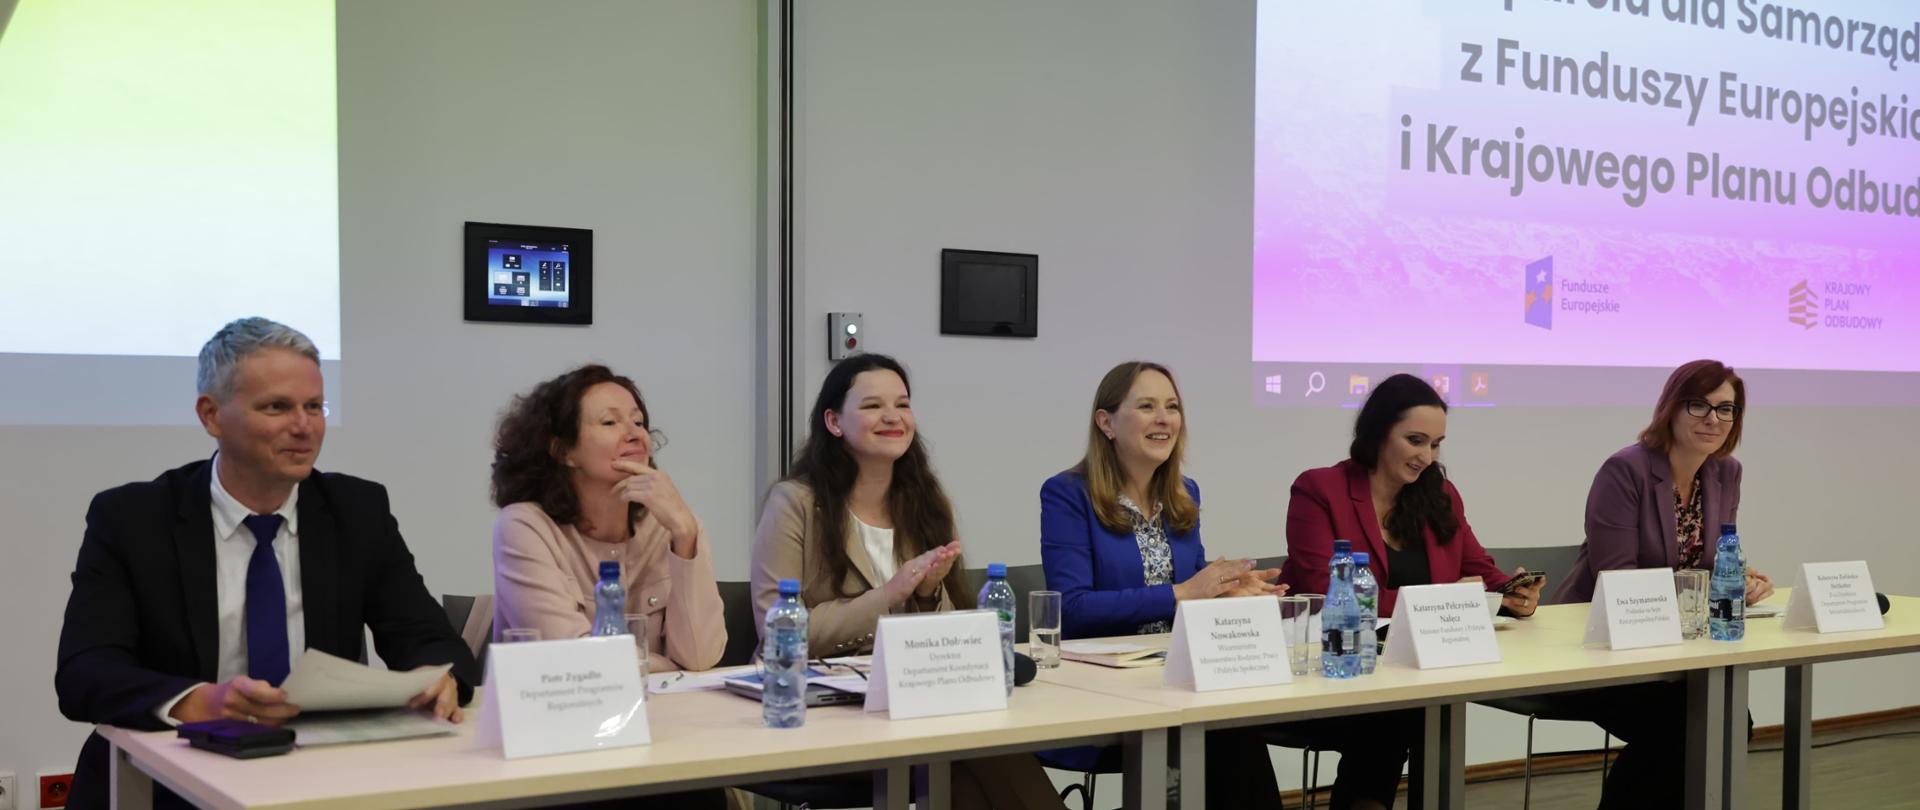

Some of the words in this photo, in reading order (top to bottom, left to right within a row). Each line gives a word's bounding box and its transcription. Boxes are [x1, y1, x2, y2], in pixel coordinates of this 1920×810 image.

[1460, 42, 1483, 83] z
[1496, 38, 1709, 127] Funduszy
[1400, 114, 1412, 170] i
[1426, 123, 1675, 208] Krajowego
[1686, 151, 1797, 206] Planu
[1561, 279, 1609, 294] Fundusze
[1825, 282, 1871, 297] KRAJOWY
[1561, 298, 1620, 313] Europejskie
[1825, 298, 1849, 312] PLAN
[1825, 315, 1882, 330] ODBUDOWY
[1413, 604, 1445, 614] Katarzyna
[1214, 617, 1252, 628] Katarzyna
[1210, 630, 1260, 640] Nowakowska
[904, 638, 940, 650] Monika
[541, 673, 563, 684] Piotr
